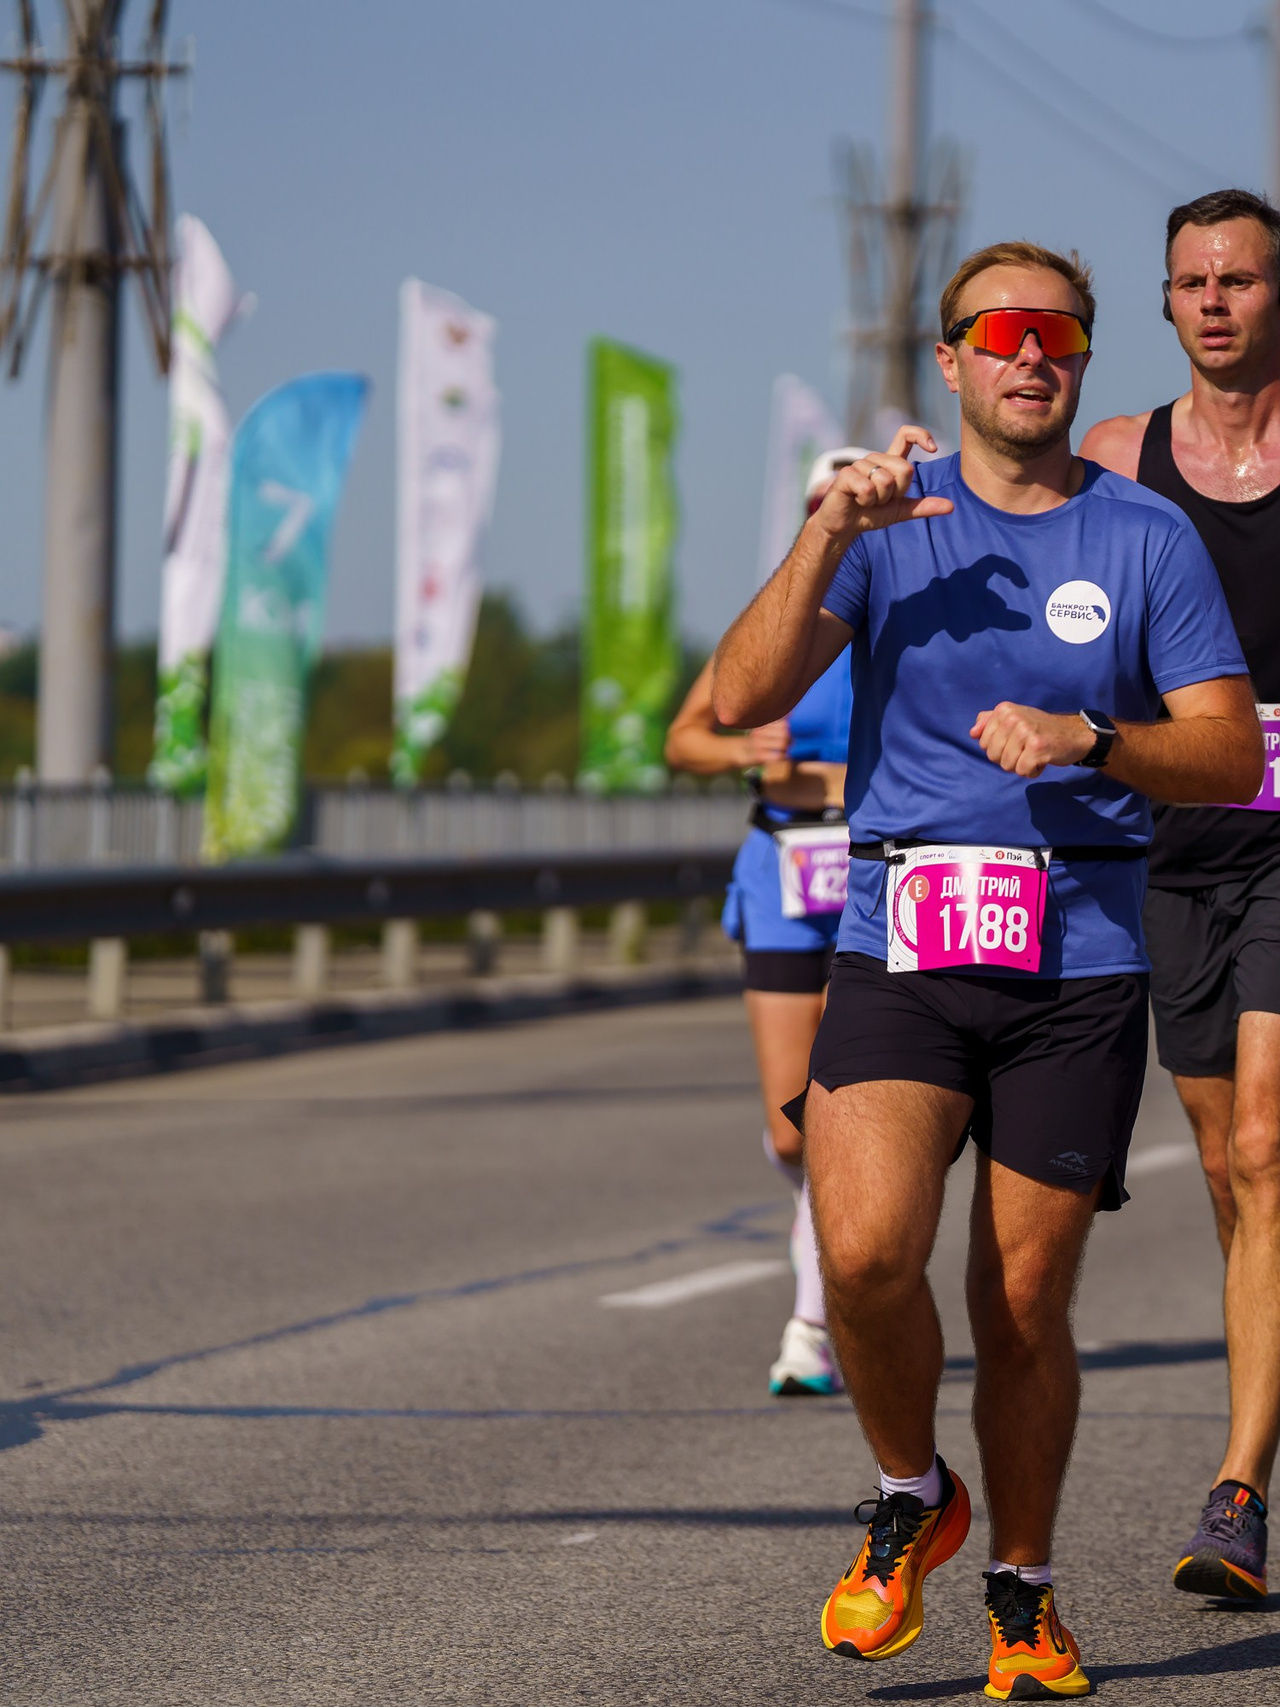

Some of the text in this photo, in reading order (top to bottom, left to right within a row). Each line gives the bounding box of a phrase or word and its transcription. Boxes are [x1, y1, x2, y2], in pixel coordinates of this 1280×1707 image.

[1051, 602, 1089, 611] БАНКРОТ
[1049, 609, 1093, 621] СЕРВИС
[1006, 851, 1022, 861] Пэй
[939, 902, 1029, 953] 1788
